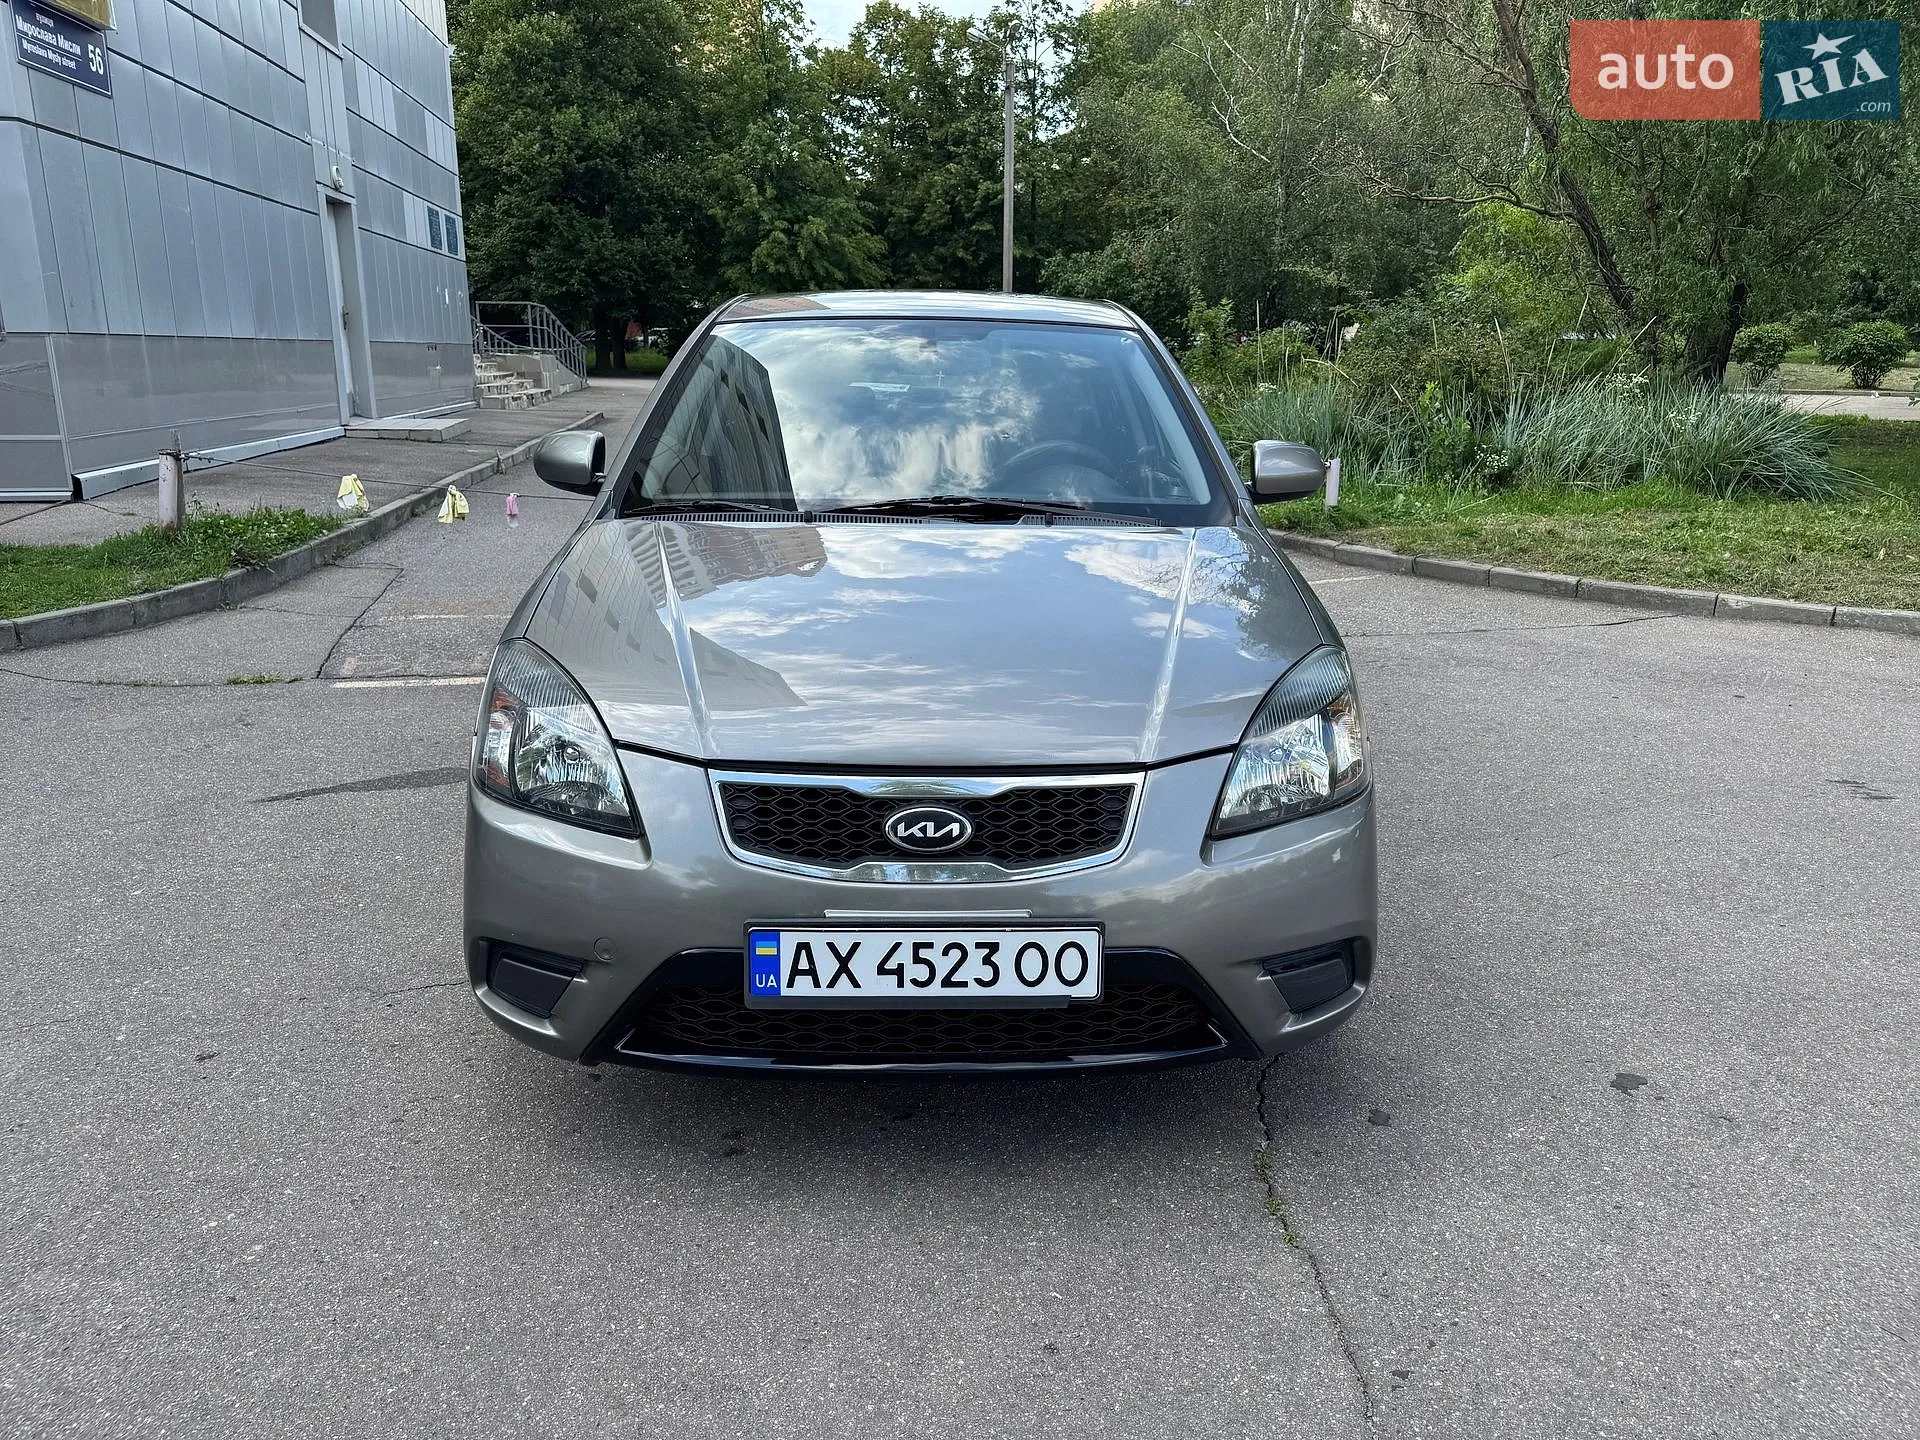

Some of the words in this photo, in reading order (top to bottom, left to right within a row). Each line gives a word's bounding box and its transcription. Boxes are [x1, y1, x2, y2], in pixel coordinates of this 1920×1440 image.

[15, 14, 57, 46] Мирослава
[57, 33, 82, 56] Мисли
[21, 38, 47, 58] Myroslava
[62, 57, 77, 70] street
[88, 43, 104, 75] 56
[897, 821, 960, 838] KIA
[755, 974, 778, 988] UA
[786, 941, 862, 989] AX
[876, 941, 1001, 989] 4523
